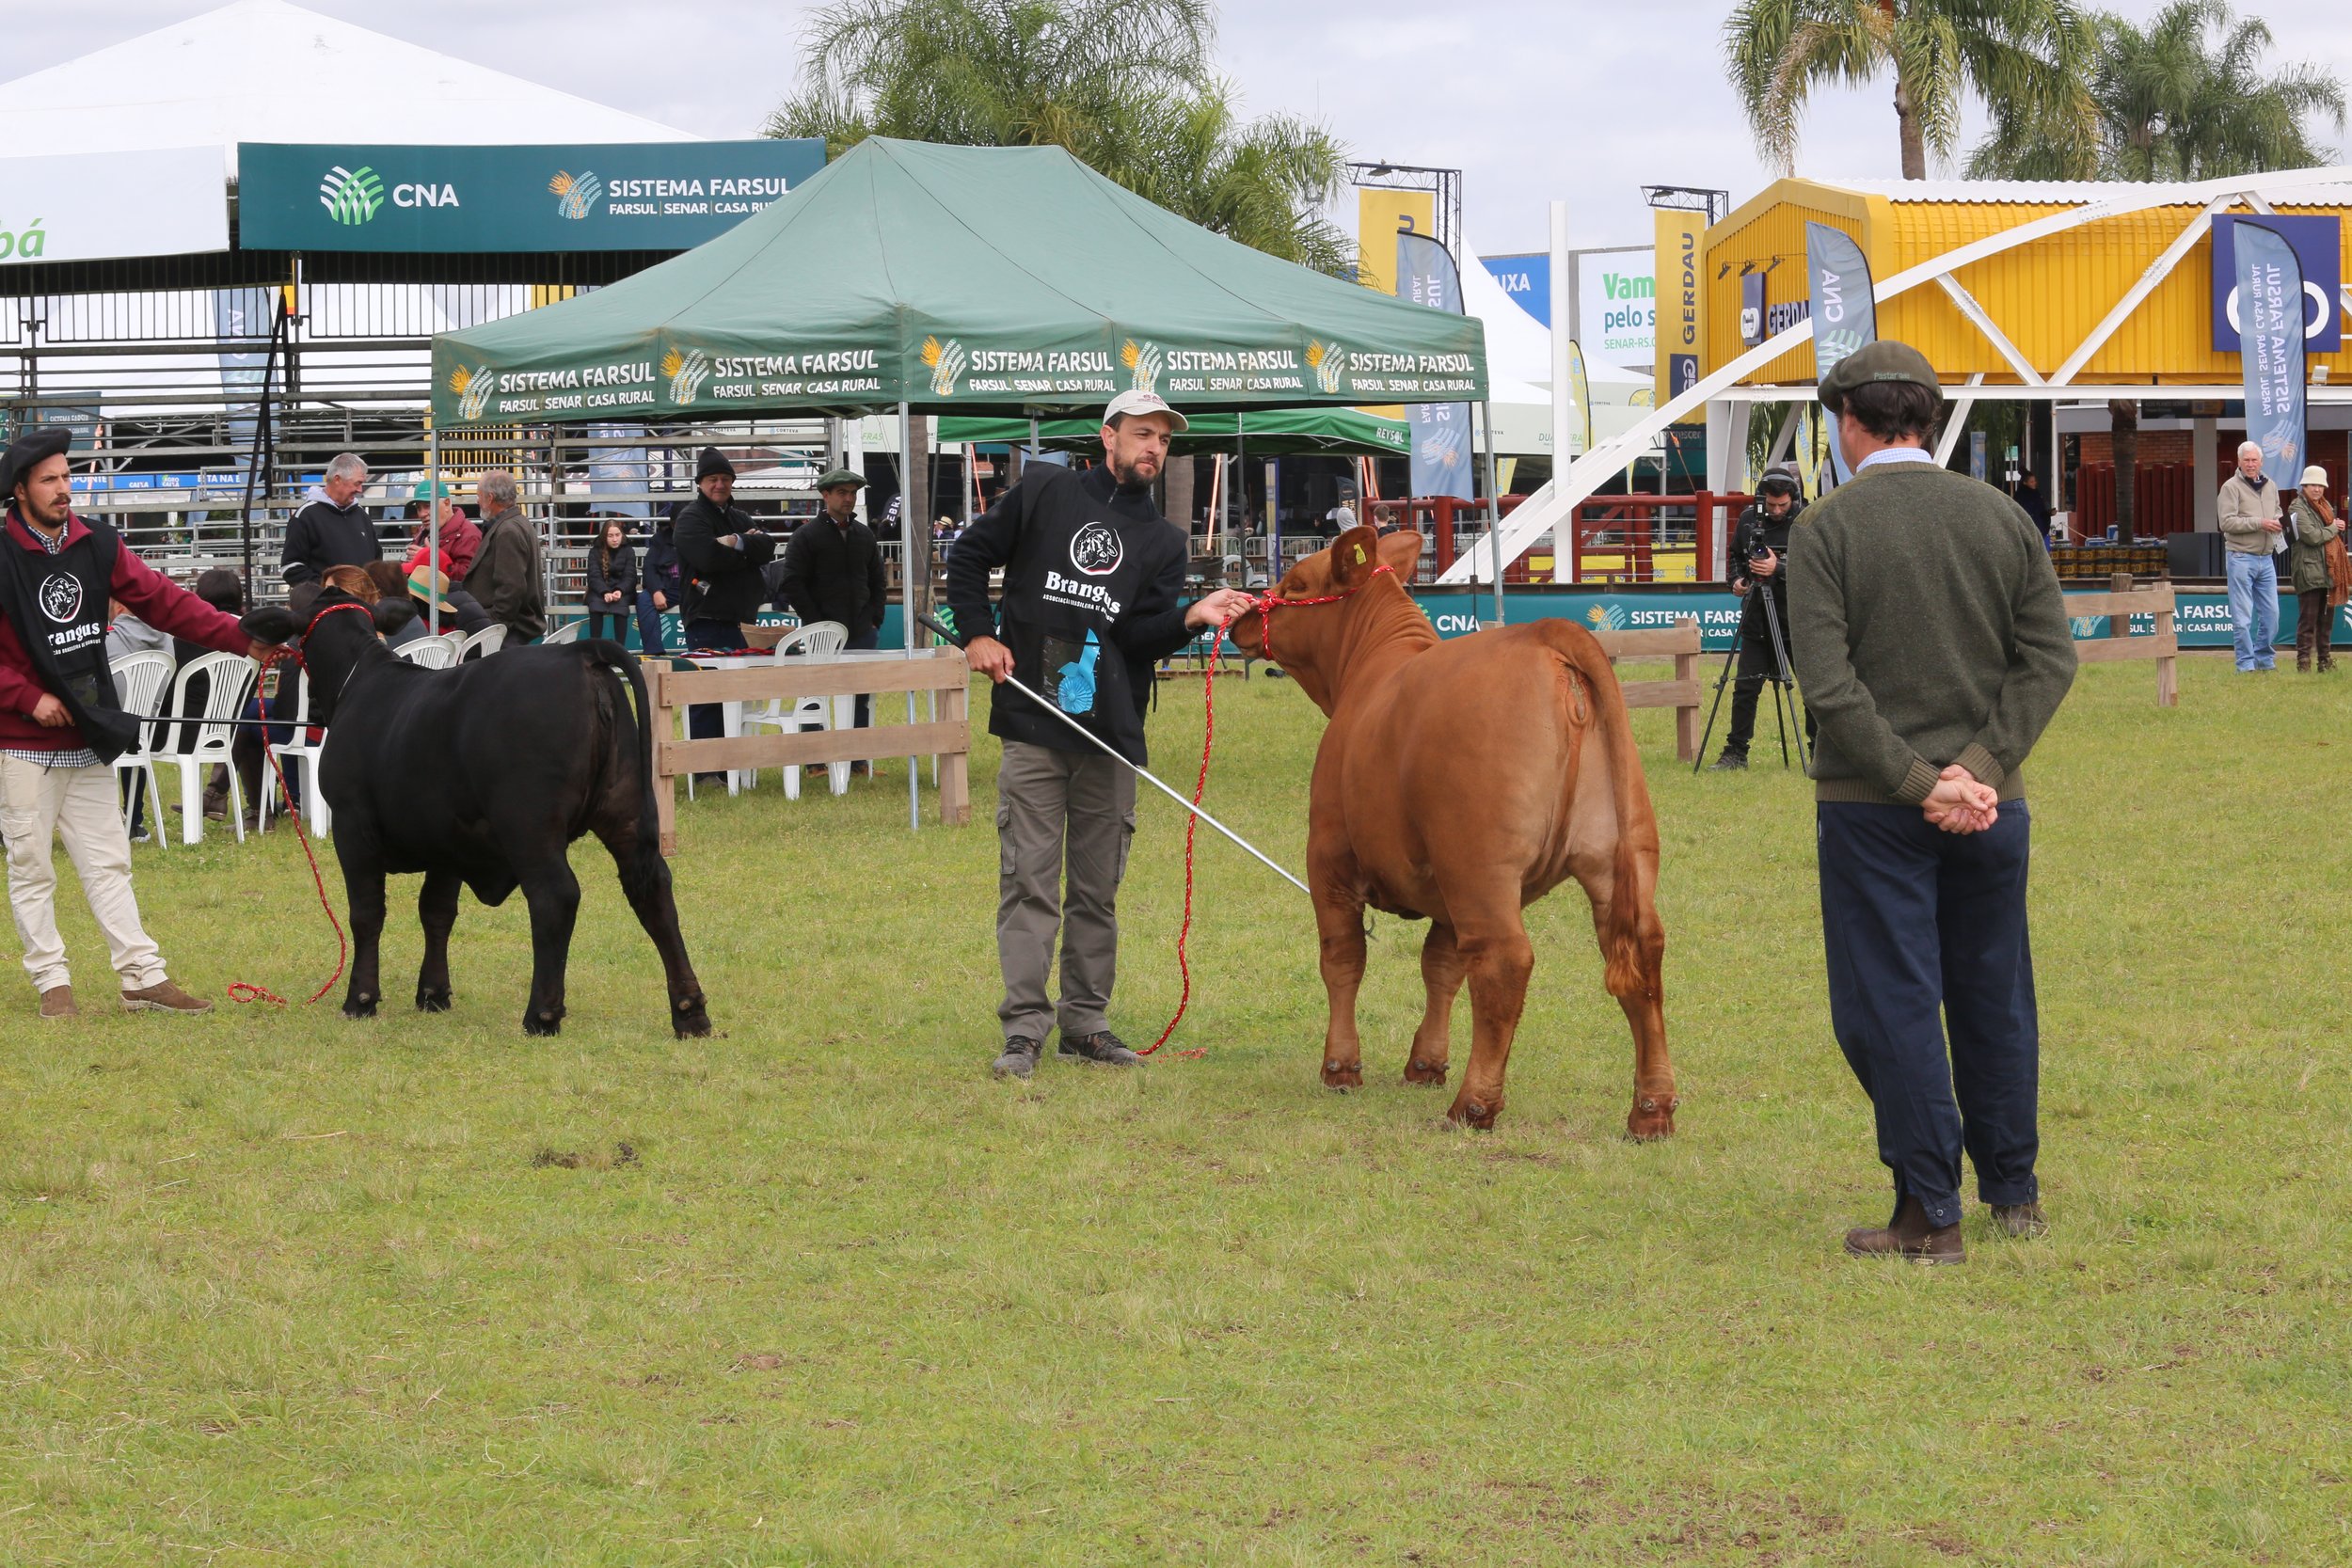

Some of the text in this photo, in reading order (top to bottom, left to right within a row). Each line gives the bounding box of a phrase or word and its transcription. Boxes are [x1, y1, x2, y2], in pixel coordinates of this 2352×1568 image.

[392, 183, 460, 208] CNA
[609, 177, 791, 198] SISTEMA FARSUL
[609, 202, 658, 215] FARSUL
[663, 202, 708, 215] SENAR
[714, 201, 749, 214] CASA
[1681, 232, 1695, 345] GERDAU
[1604, 305, 1643, 333] pelo
[1768, 300, 1809, 336] GERDA
[713, 349, 879, 378] SISTEMA FARSUL
[970, 350, 1114, 372] SISTEMA FARSUL
[1167, 350, 1298, 372] SISTEMA FARSUL
[1349, 352, 1475, 373] SISTEMA FARSUL
[500, 362, 656, 393] SISTEMA FARSUL
[713, 377, 882, 399] FARSUL SENAR CASA RURAL
[969, 378, 1117, 392] FARSUL SENAR CASA RURAL
[1169, 376, 1304, 391] FARSUL SENAR CASA RURAL
[1352, 378, 1476, 392] FARSUL SENAR CASA RURAL
[500, 390, 656, 414] FARSUL SENAR CASA RURAL
[1375, 427, 1405, 443] REYSOL
[1044, 570, 1121, 614] Brangus
[1630, 610, 1701, 625] SISTEMA
[2184, 605, 2232, 619] FARSU
[1436, 614, 1481, 632] CNA
[1708, 628, 1733, 637] CASA
[2187, 623, 2213, 632] CASA
